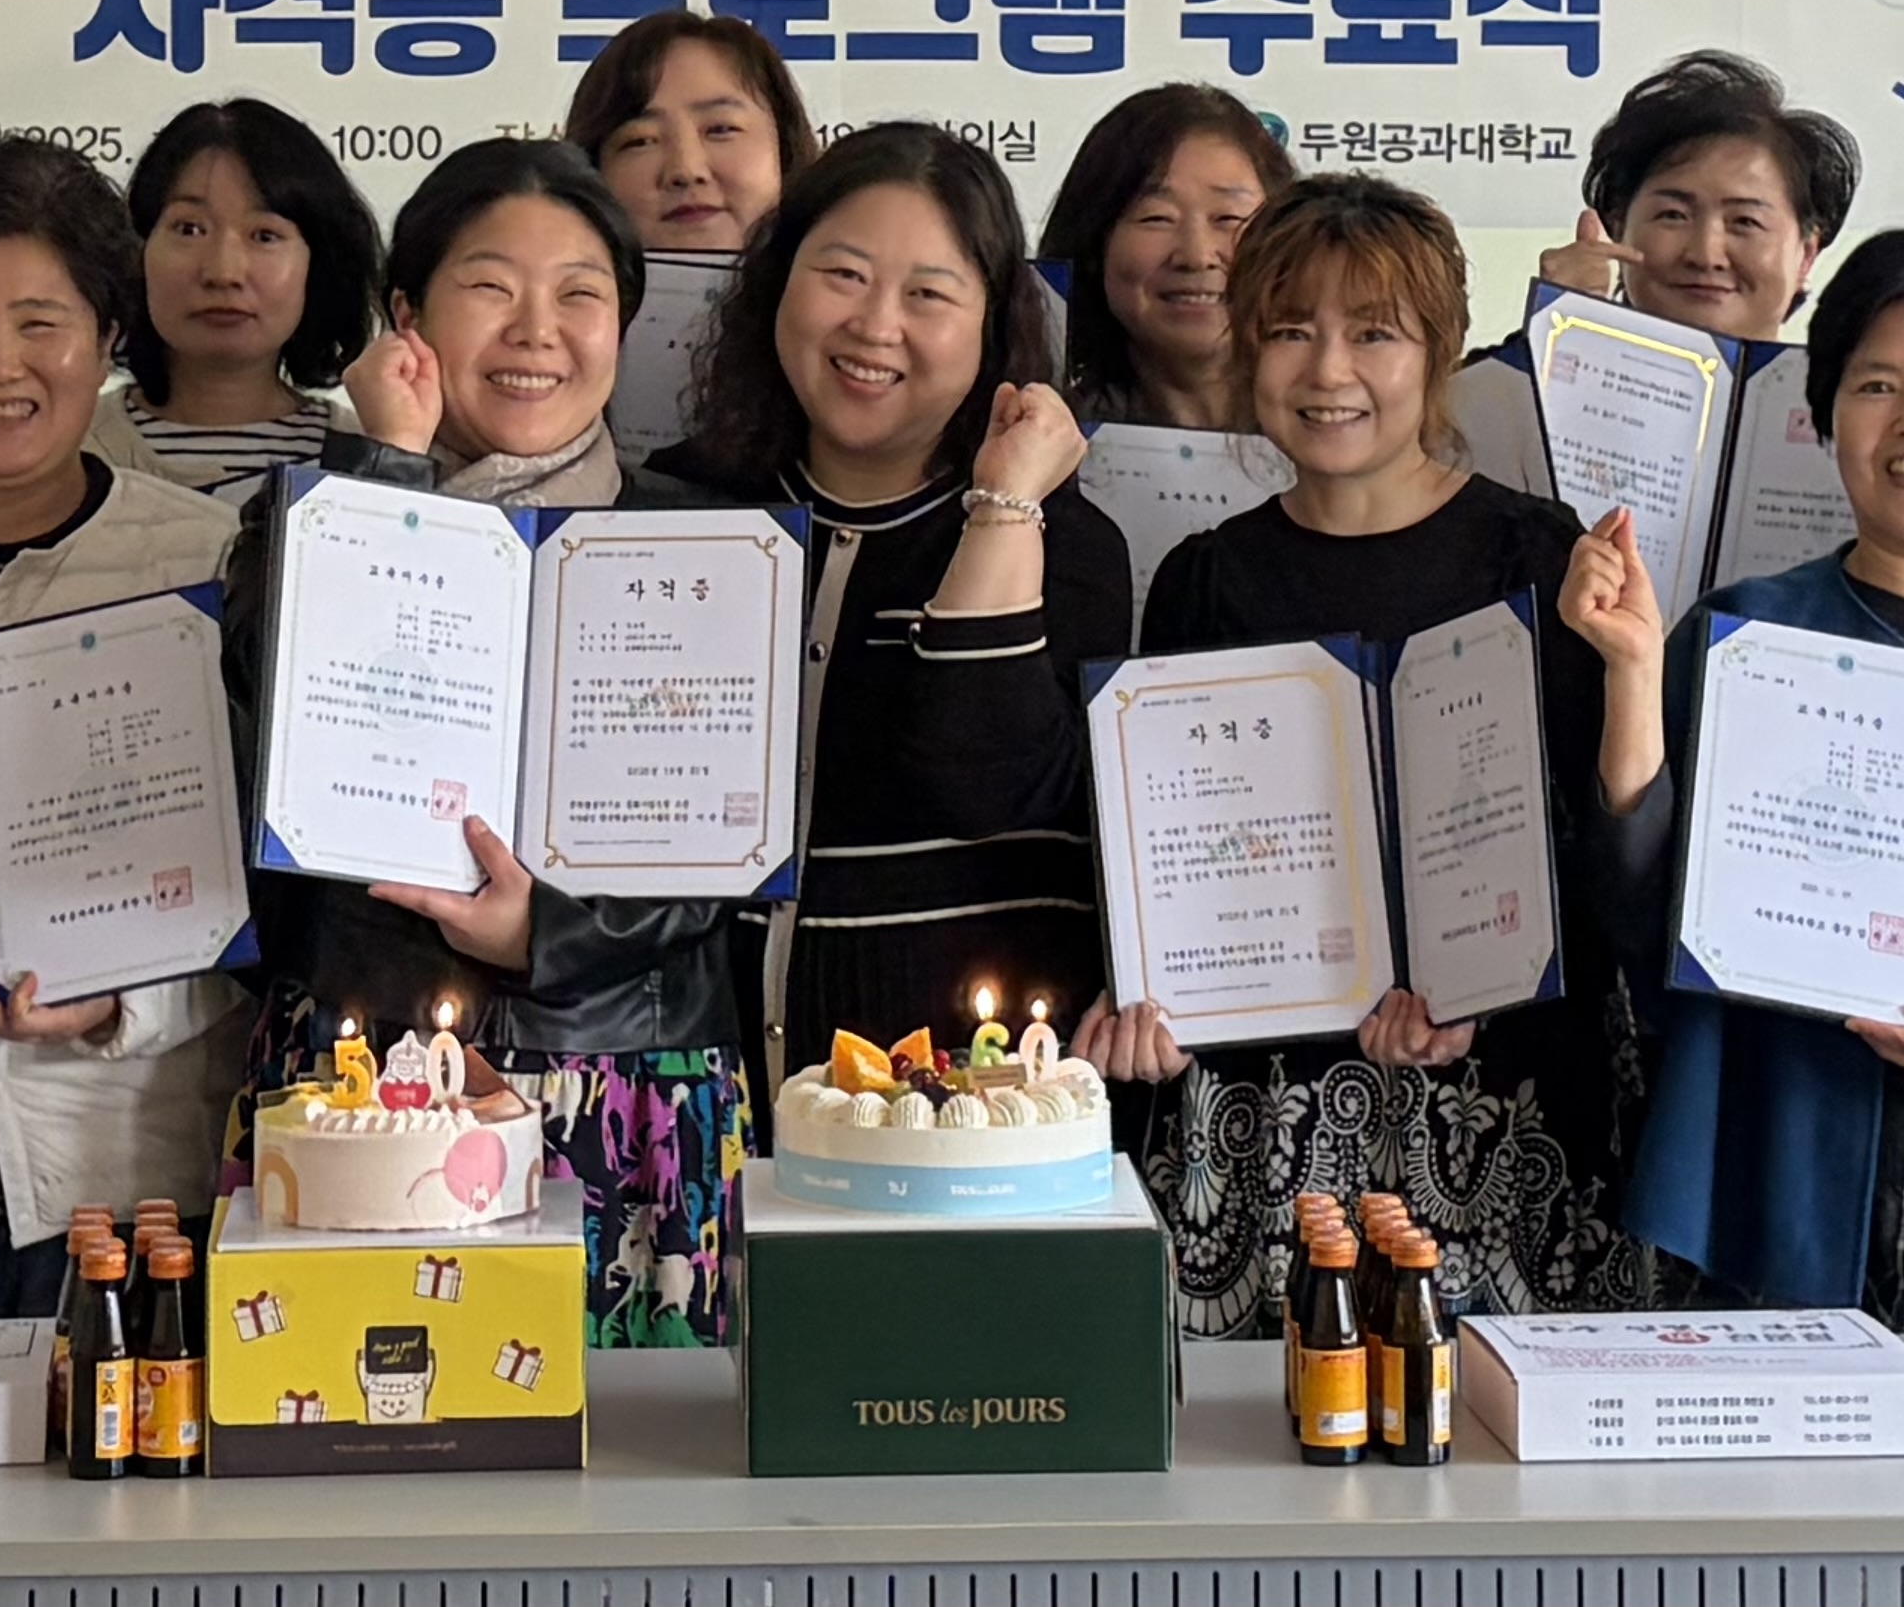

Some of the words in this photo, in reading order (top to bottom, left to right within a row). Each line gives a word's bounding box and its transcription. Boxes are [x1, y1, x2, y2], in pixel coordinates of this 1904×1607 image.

[332, 124, 443, 162] 10:00
[1298, 121, 1578, 164] 두원공과대학교
[852, 1399, 935, 1426] TOUS
[939, 1398, 969, 1424] les
[971, 1397, 1066, 1429] JOURS
